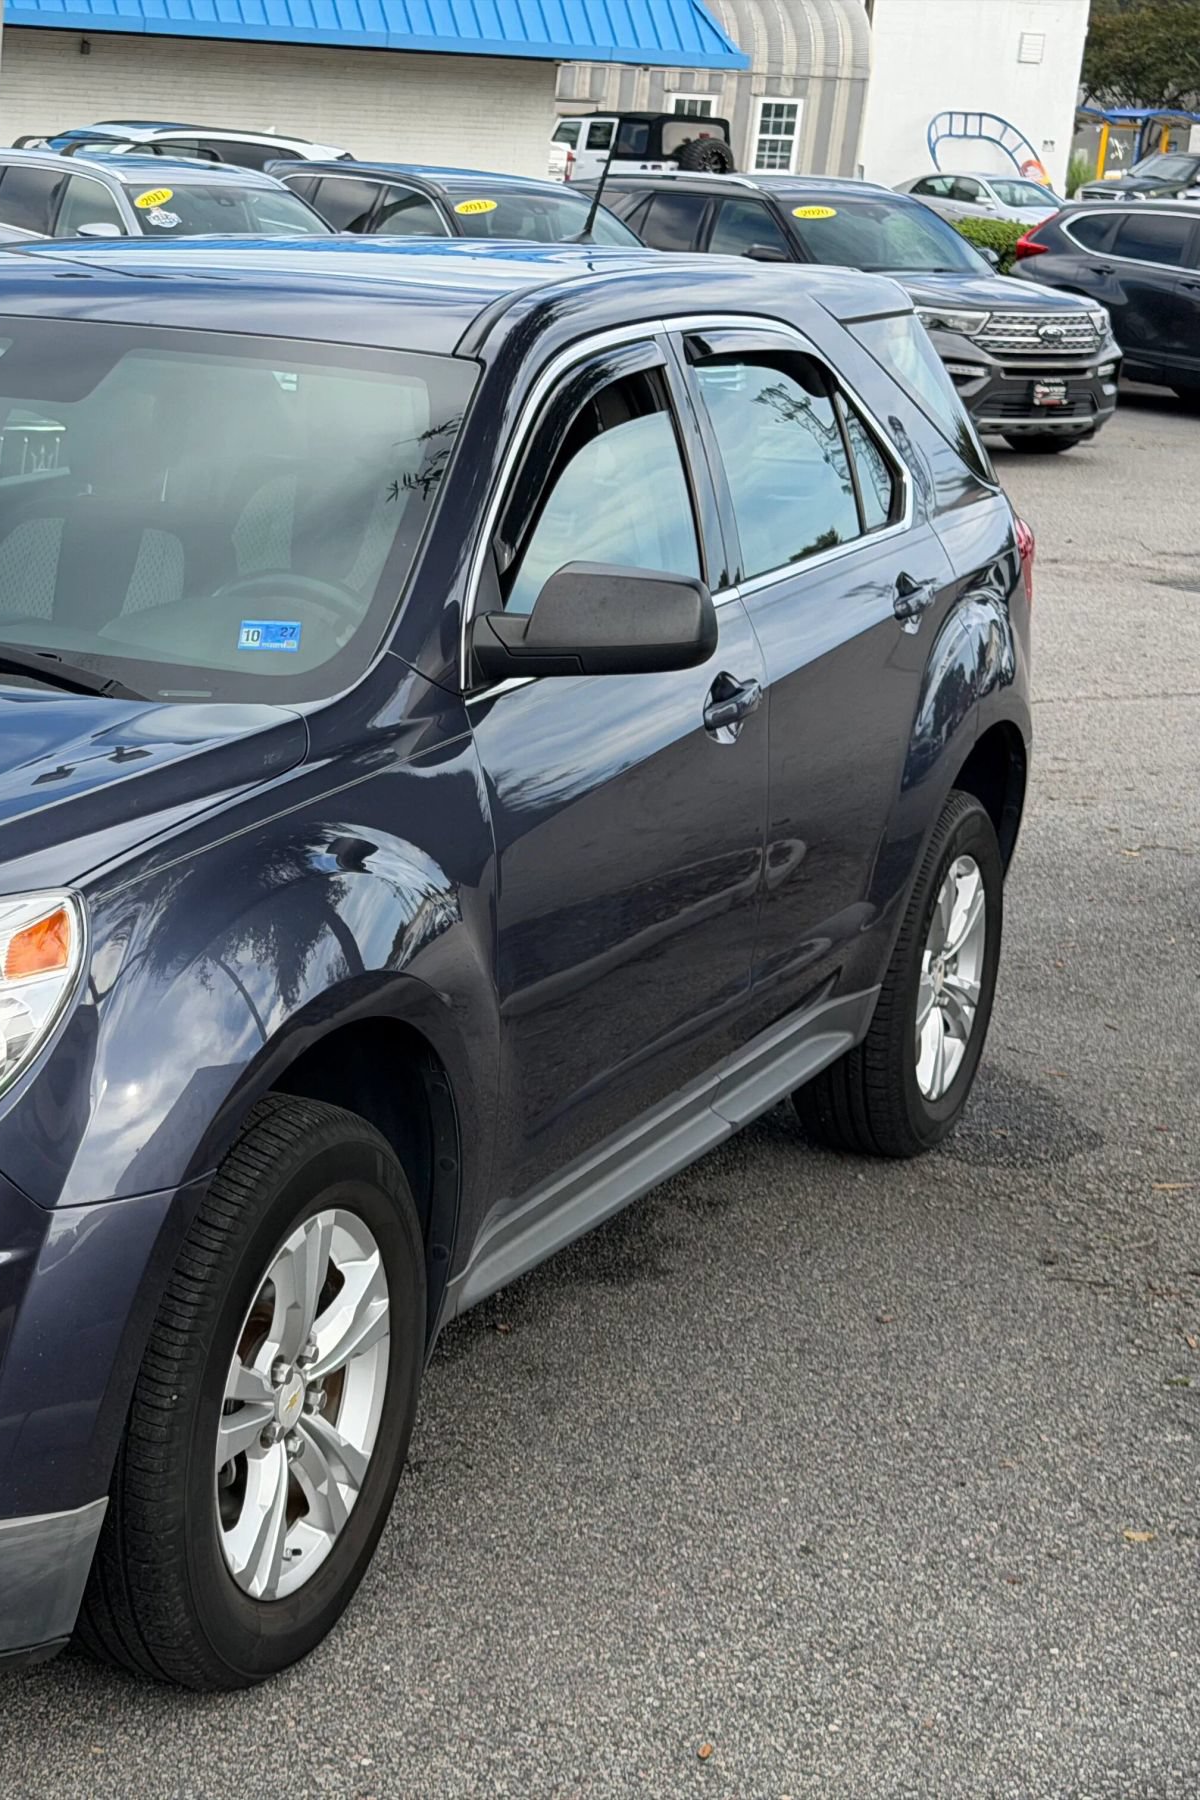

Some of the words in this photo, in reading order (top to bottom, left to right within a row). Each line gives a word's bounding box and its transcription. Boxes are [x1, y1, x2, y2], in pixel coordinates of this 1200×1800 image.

[141, 190, 166, 206] 2017
[244, 629, 261, 642] 10
[280, 626, 297, 638] 27
